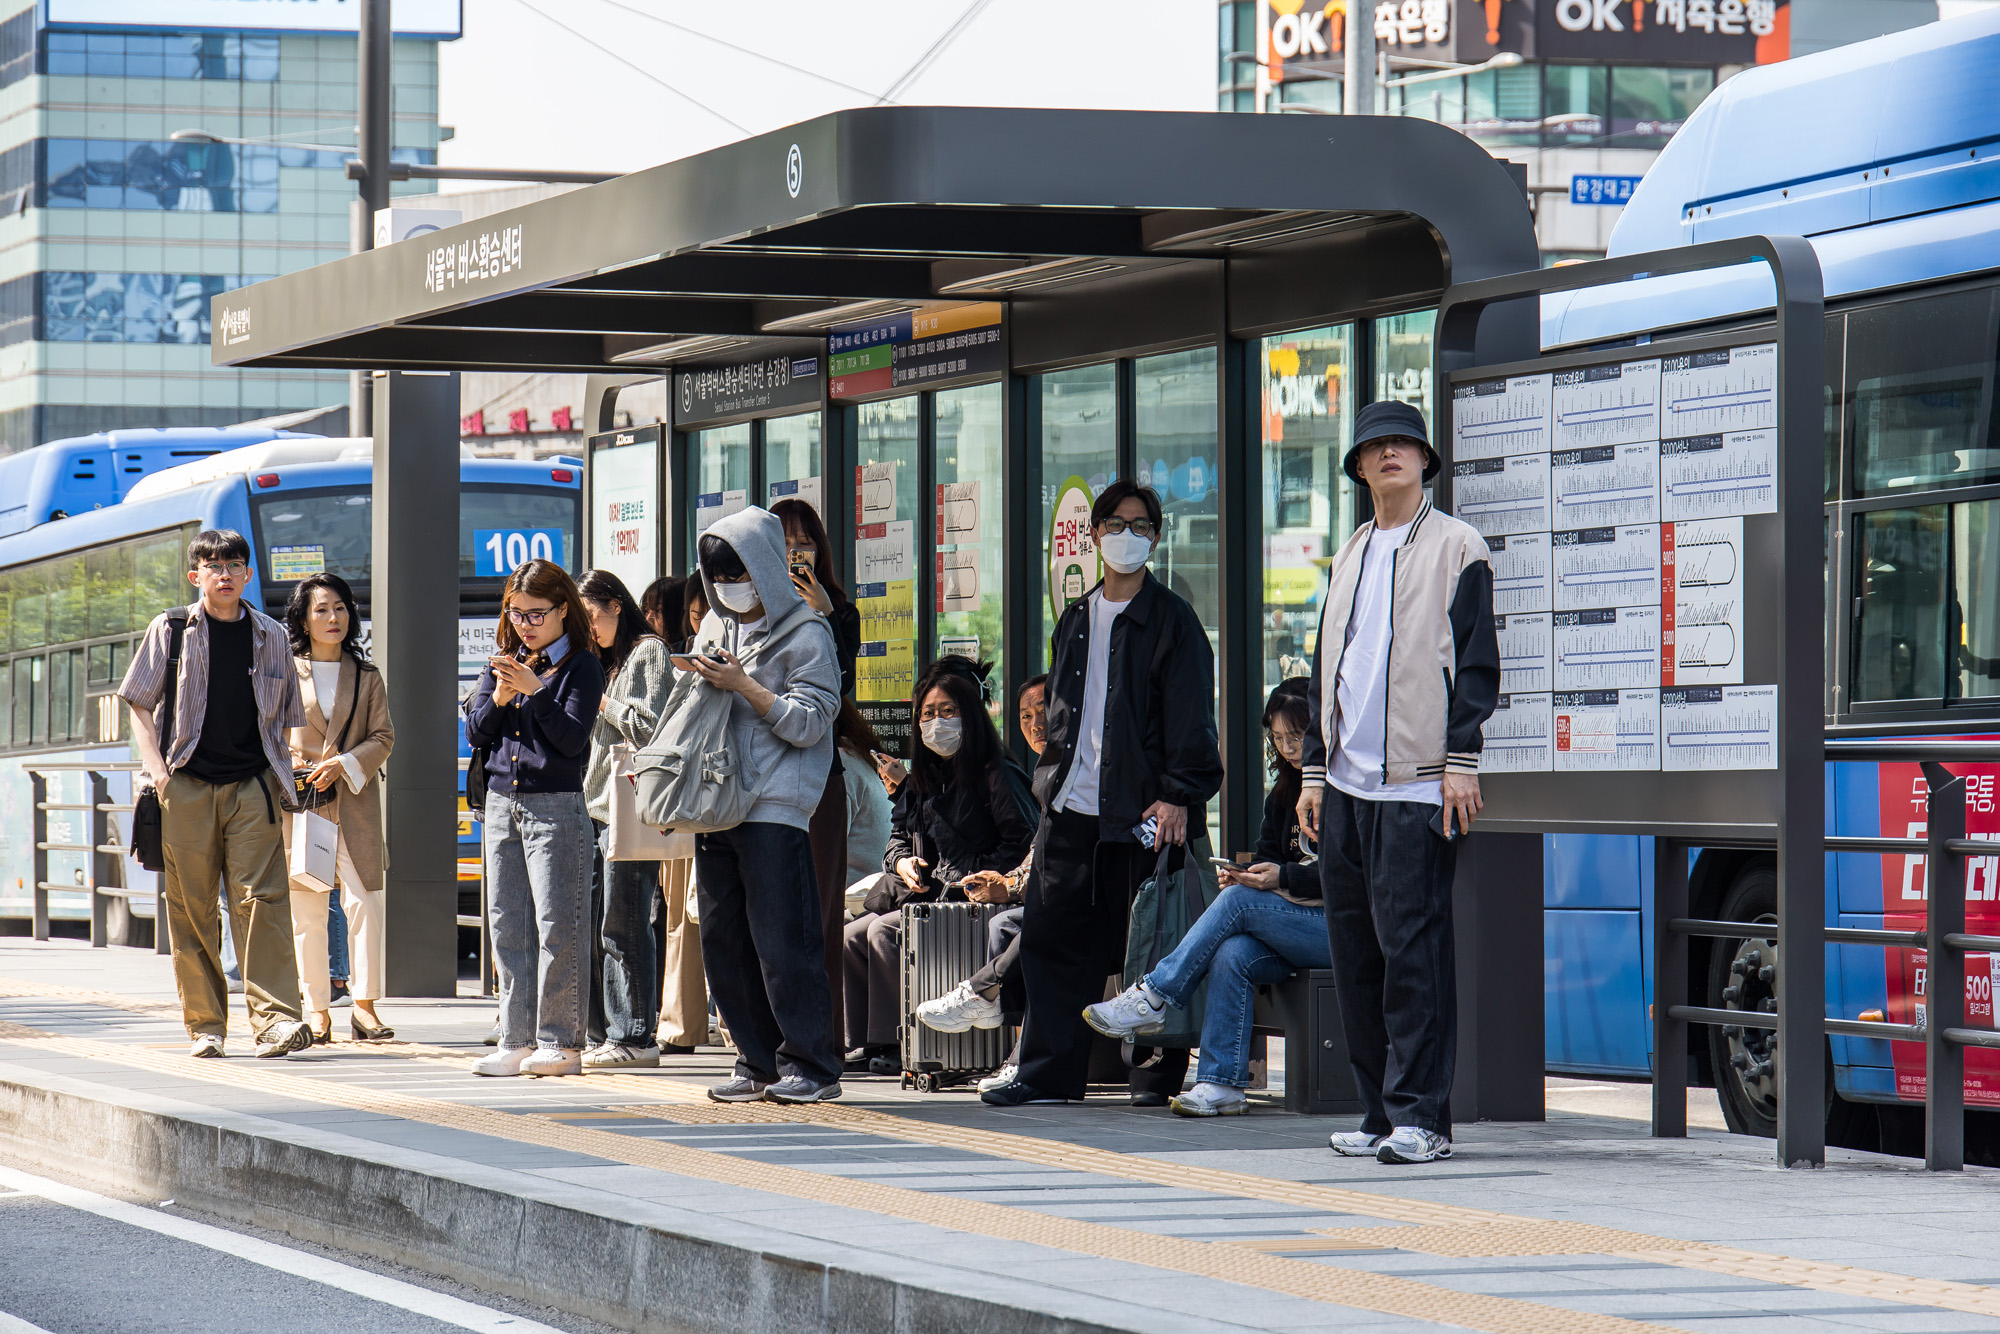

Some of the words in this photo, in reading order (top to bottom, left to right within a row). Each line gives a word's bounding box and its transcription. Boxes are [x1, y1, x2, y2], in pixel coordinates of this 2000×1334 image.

[1374, 0, 1449, 45] 축은행
[1655, 0, 1776, 36] 저축은행
[1575, 178, 1638, 201] 한강대교
[425, 243, 455, 293] 서울역
[458, 223, 522, 284] 버스환승센터
[486, 532, 554, 573] 100
[616, 528, 640, 556] 1억까지!
[1055, 519, 1077, 556] 금연
[98, 694, 119, 742] 100
[314, 843, 330, 855] CHANEL
[1966, 975, 1990, 1001] 500
[1970, 1002, 1991, 1016] 밀리그램
